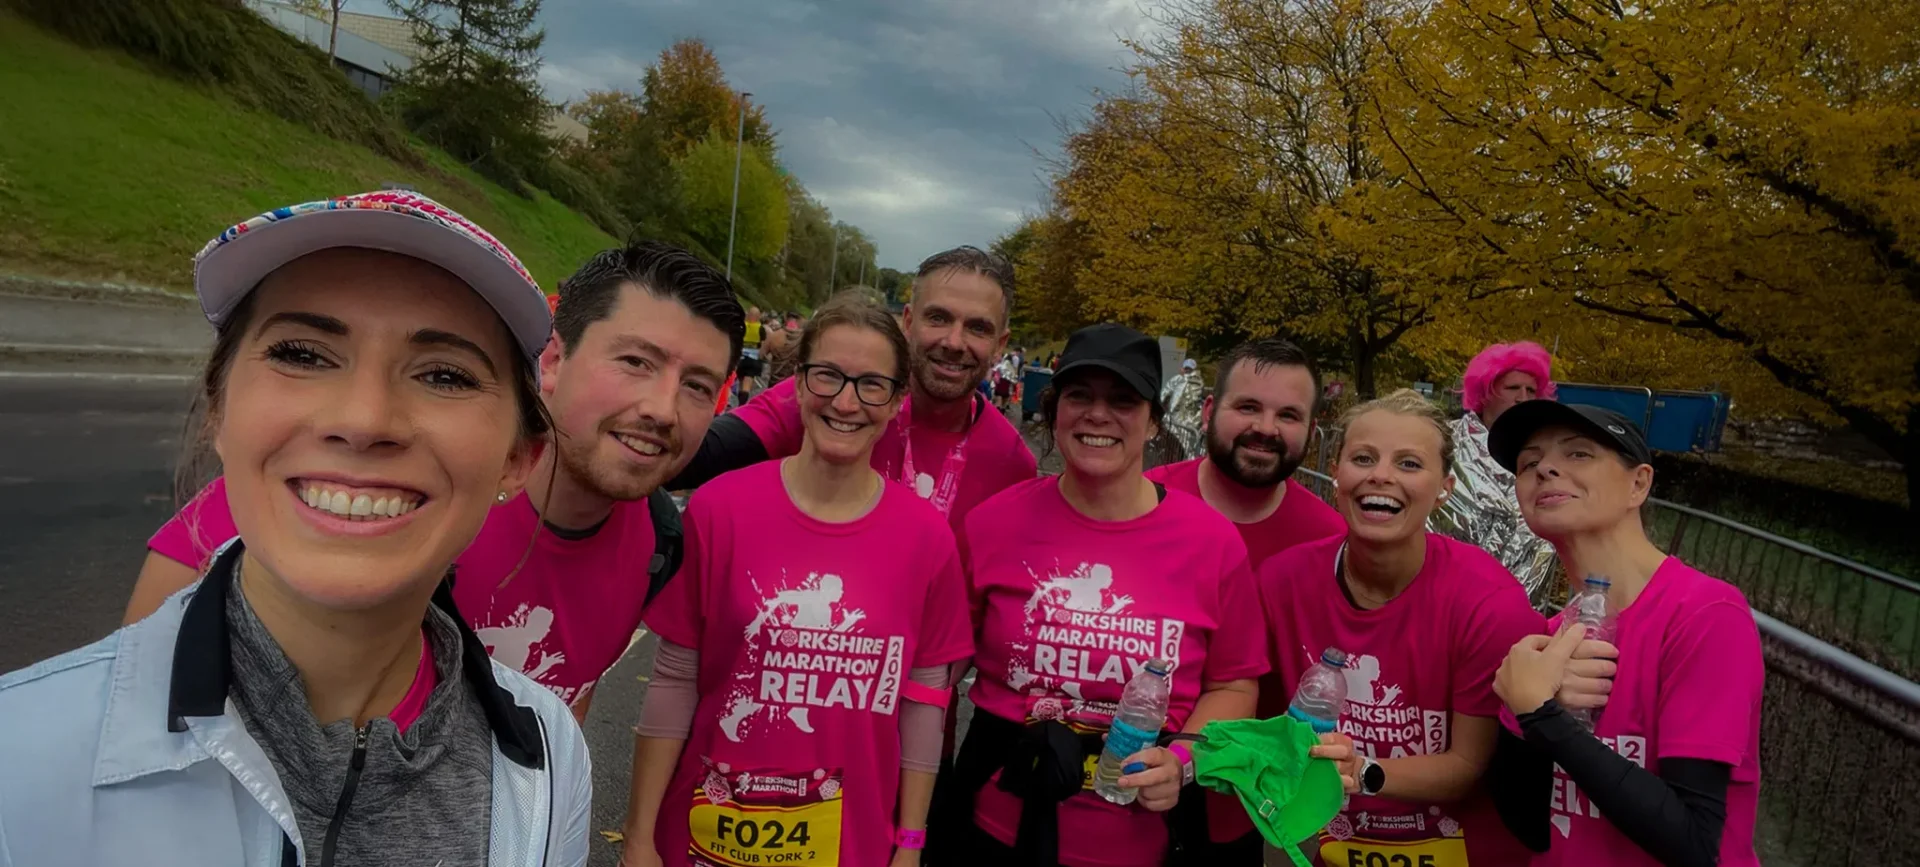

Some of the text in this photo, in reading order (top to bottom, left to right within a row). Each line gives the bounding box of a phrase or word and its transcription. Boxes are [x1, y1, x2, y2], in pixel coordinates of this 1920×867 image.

[1044, 605, 1156, 636] YORKSHIRE
[767, 628, 885, 655] YORKSHIRE
[1037, 625, 1155, 657] MARATHON
[763, 650, 879, 676] MARATHON
[878, 641, 900, 709] 2024
[760, 670, 874, 710] RELAY
[1429, 715, 1443, 754] 202
[752, 784, 797, 794] MARATHON
[717, 814, 810, 849] F024
[710, 841, 726, 855] FIT
[730, 849, 760, 863] CLUB
[765, 852, 802, 863] YORK
[808, 850, 816, 860] 2
